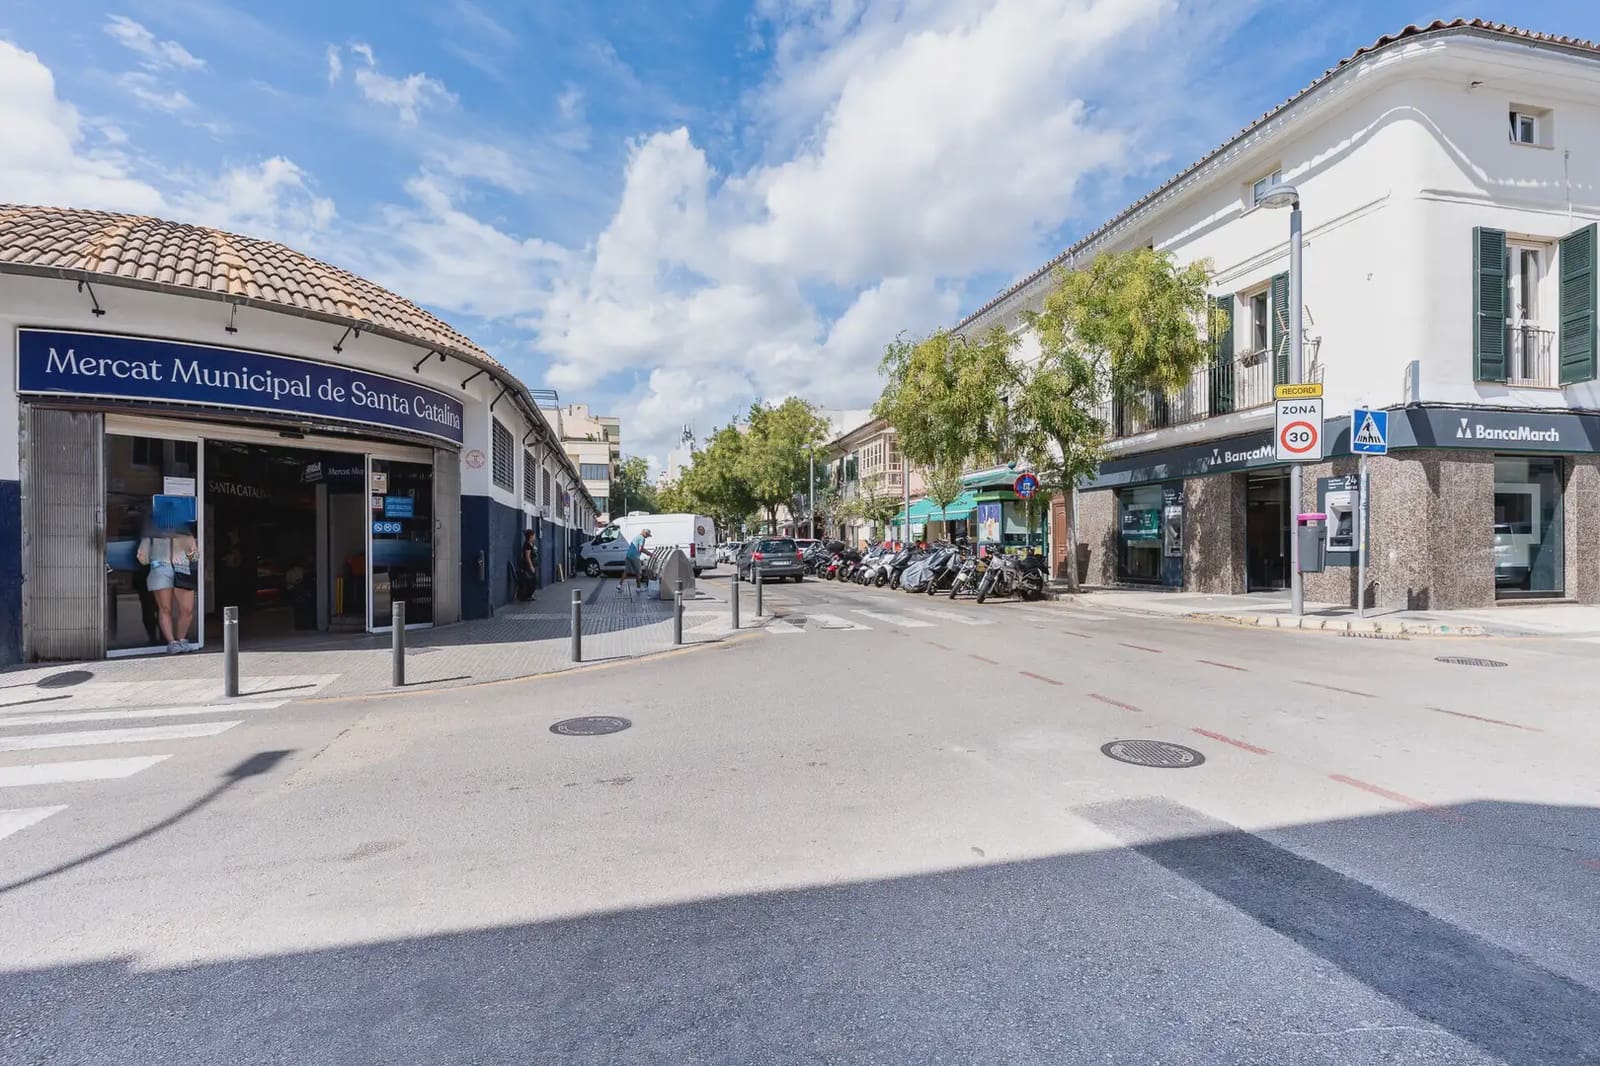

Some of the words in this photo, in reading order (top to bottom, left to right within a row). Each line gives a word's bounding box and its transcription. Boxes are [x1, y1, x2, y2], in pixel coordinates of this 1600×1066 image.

[45, 347, 163, 381] Mercat
[171, 358, 311, 400] Municipal
[317, 378, 346, 403] de
[351, 381, 410, 416] Santa
[413, 395, 461, 430] Catalina
[1282, 387, 1317, 395] RECORDI
[1282, 405, 1316, 415] ZONA
[1289, 432, 1310, 443] 30
[1475, 424, 1560, 442] BancaMarch
[1344, 475, 1358, 485] 24
[208, 480, 236, 495] SANTA
[236, 483, 273, 499] CATALIN
